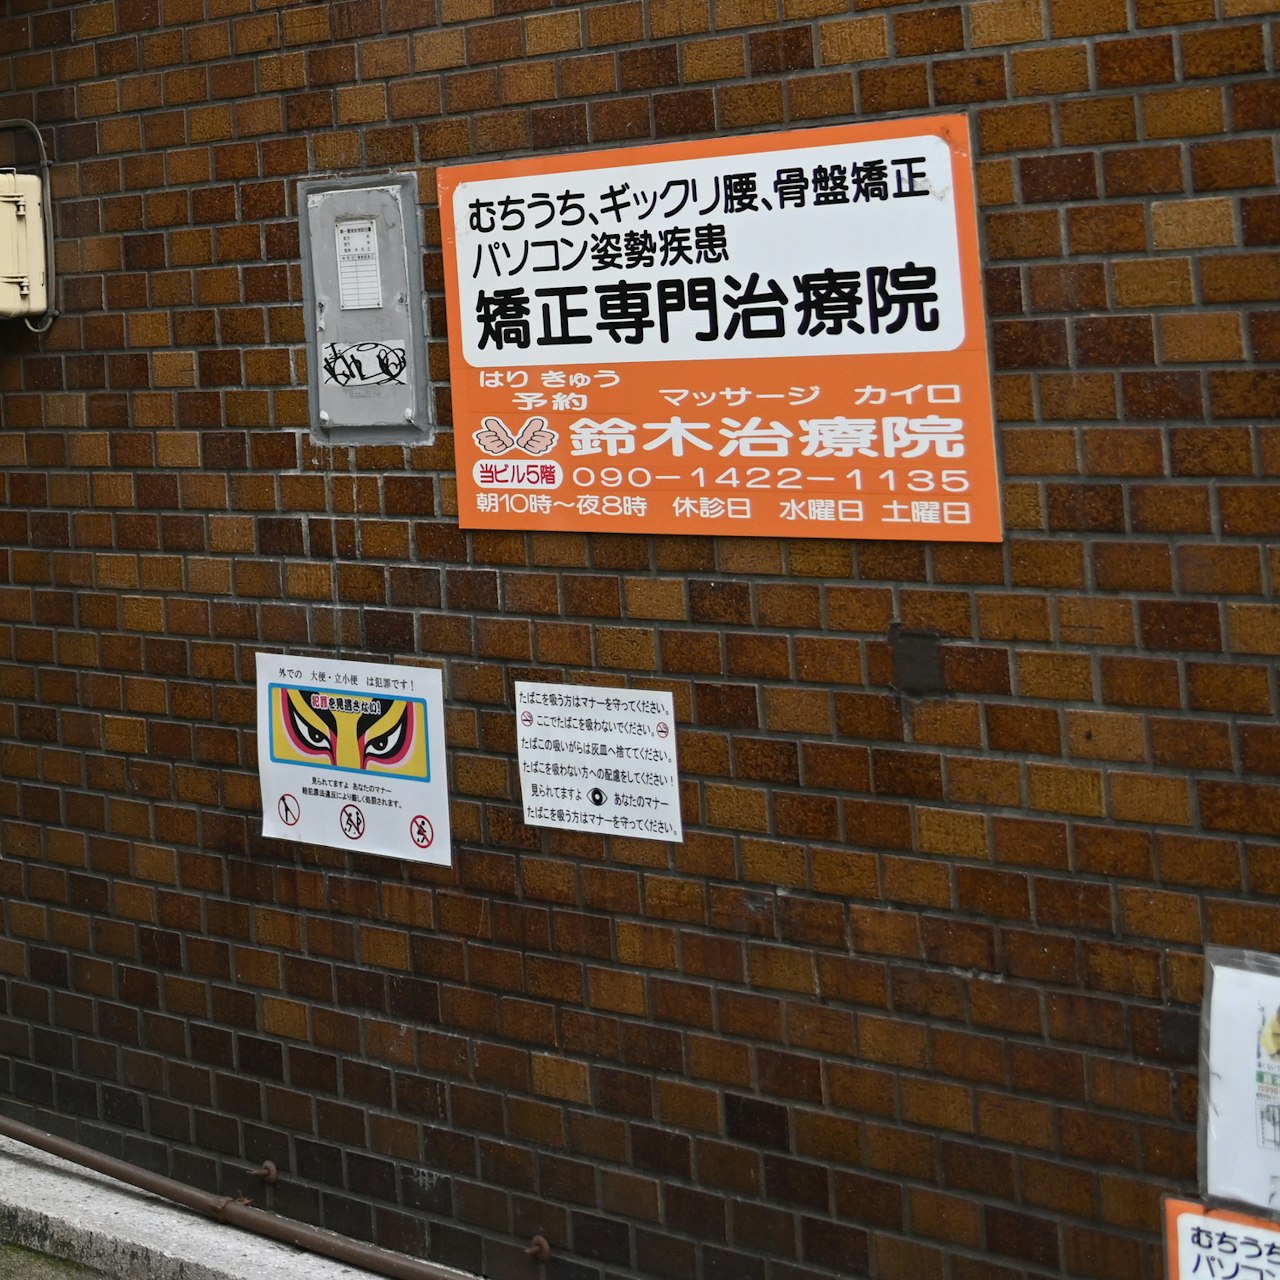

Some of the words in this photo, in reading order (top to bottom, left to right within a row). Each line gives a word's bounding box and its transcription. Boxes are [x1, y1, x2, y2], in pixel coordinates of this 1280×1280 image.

[468, 156, 930, 233] むちうち、ギックリ腰、骨盤矯正
[473, 223, 729, 279] パソコン姿勢疾患
[477, 262, 940, 351] 矯正専門治療院
[479, 370, 528, 389] はり
[540, 369, 621, 389] きゅう
[512, 392, 588, 411] 予約
[658, 385, 821, 407] マッサージ
[854, 384, 961, 405] カイロ
[569, 415, 965, 459] 鈴木治療院
[479, 463, 556, 485] 当ビル5階
[572, 467, 970, 493] 090-1422-1135
[476, 493, 648, 517] 朝10時～夜8時
[672, 496, 751, 519] 休診日
[779, 499, 864, 522] 水曜日
[881, 500, 972, 524] 土曜日
[278, 667, 303, 679] 外での
[310, 670, 358, 686] 大便・立小便
[366, 676, 415, 691] は犯罪です！
[519, 691, 670, 716] たばこを吸う方はマナーを守ってください。
[537, 715, 655, 737] ここでたばこを吸わないでください。
[521, 737, 672, 763] たばこの吸いがらは灰皿へ捨ててください。
[311, 776, 349, 789] 見られてますよ
[352, 782, 392, 795] あなたのマナー
[531, 783, 582, 801] 見られてますよ
[614, 792, 669, 809] あなたのマナー
[527, 805, 677, 835] たばこを吸う方はマナーを守ってください。
